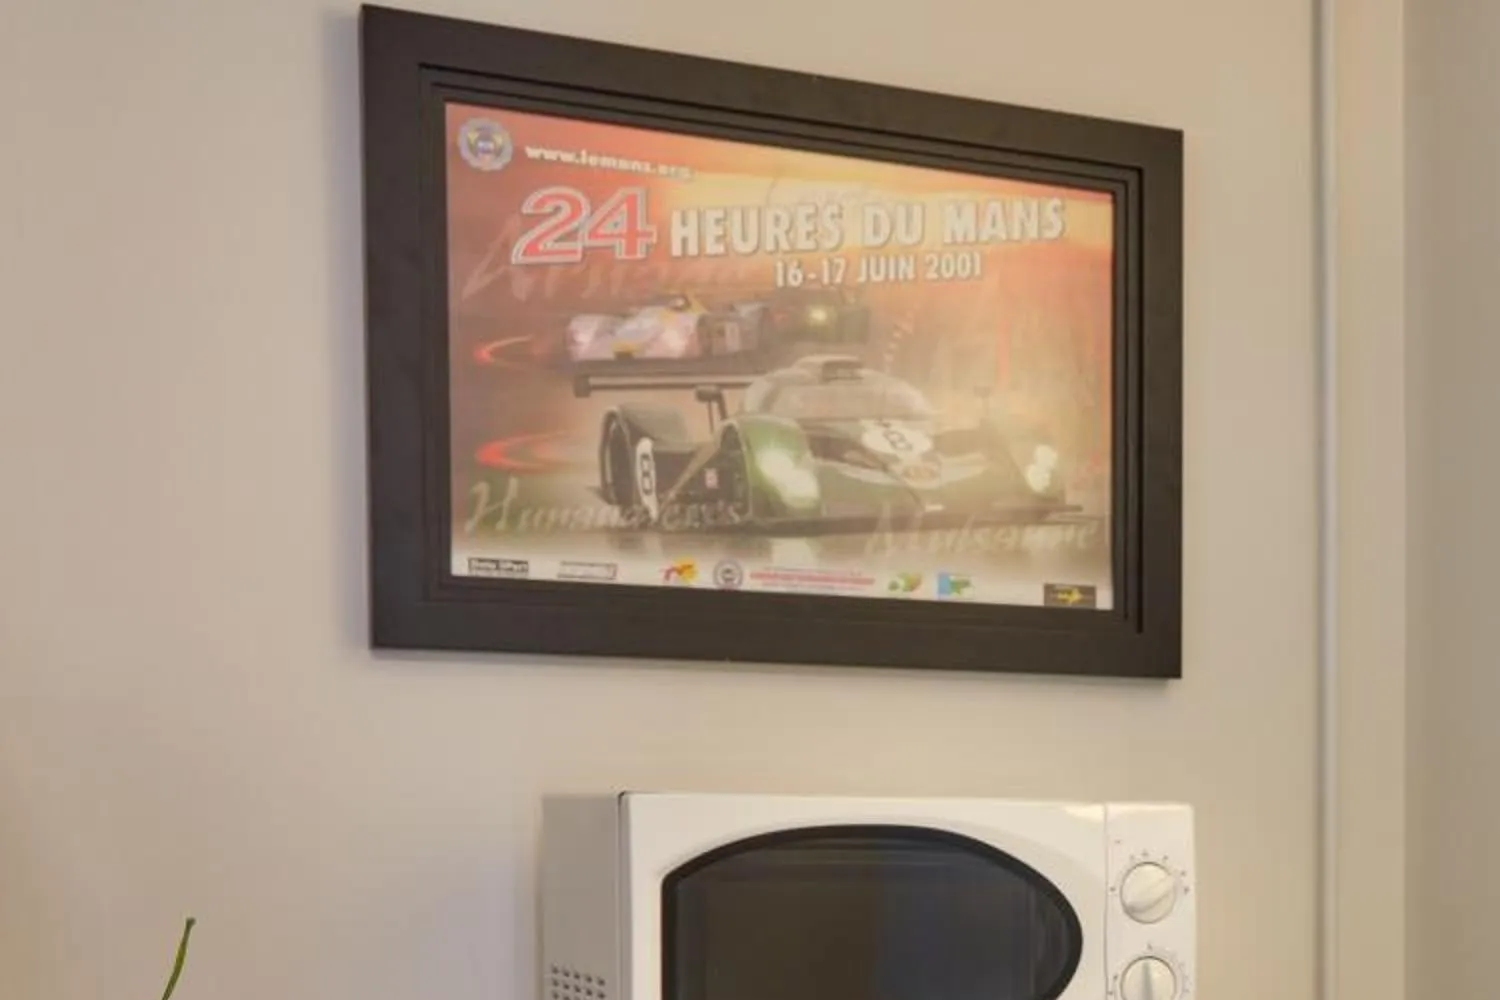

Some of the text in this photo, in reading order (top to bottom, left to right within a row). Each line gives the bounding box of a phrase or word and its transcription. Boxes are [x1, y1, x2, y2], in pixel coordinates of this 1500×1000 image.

[511, 186, 1067, 265] 24 HEURES DU MANS
[857, 254, 915, 284] JUIN
[925, 251, 982, 281] 2001
